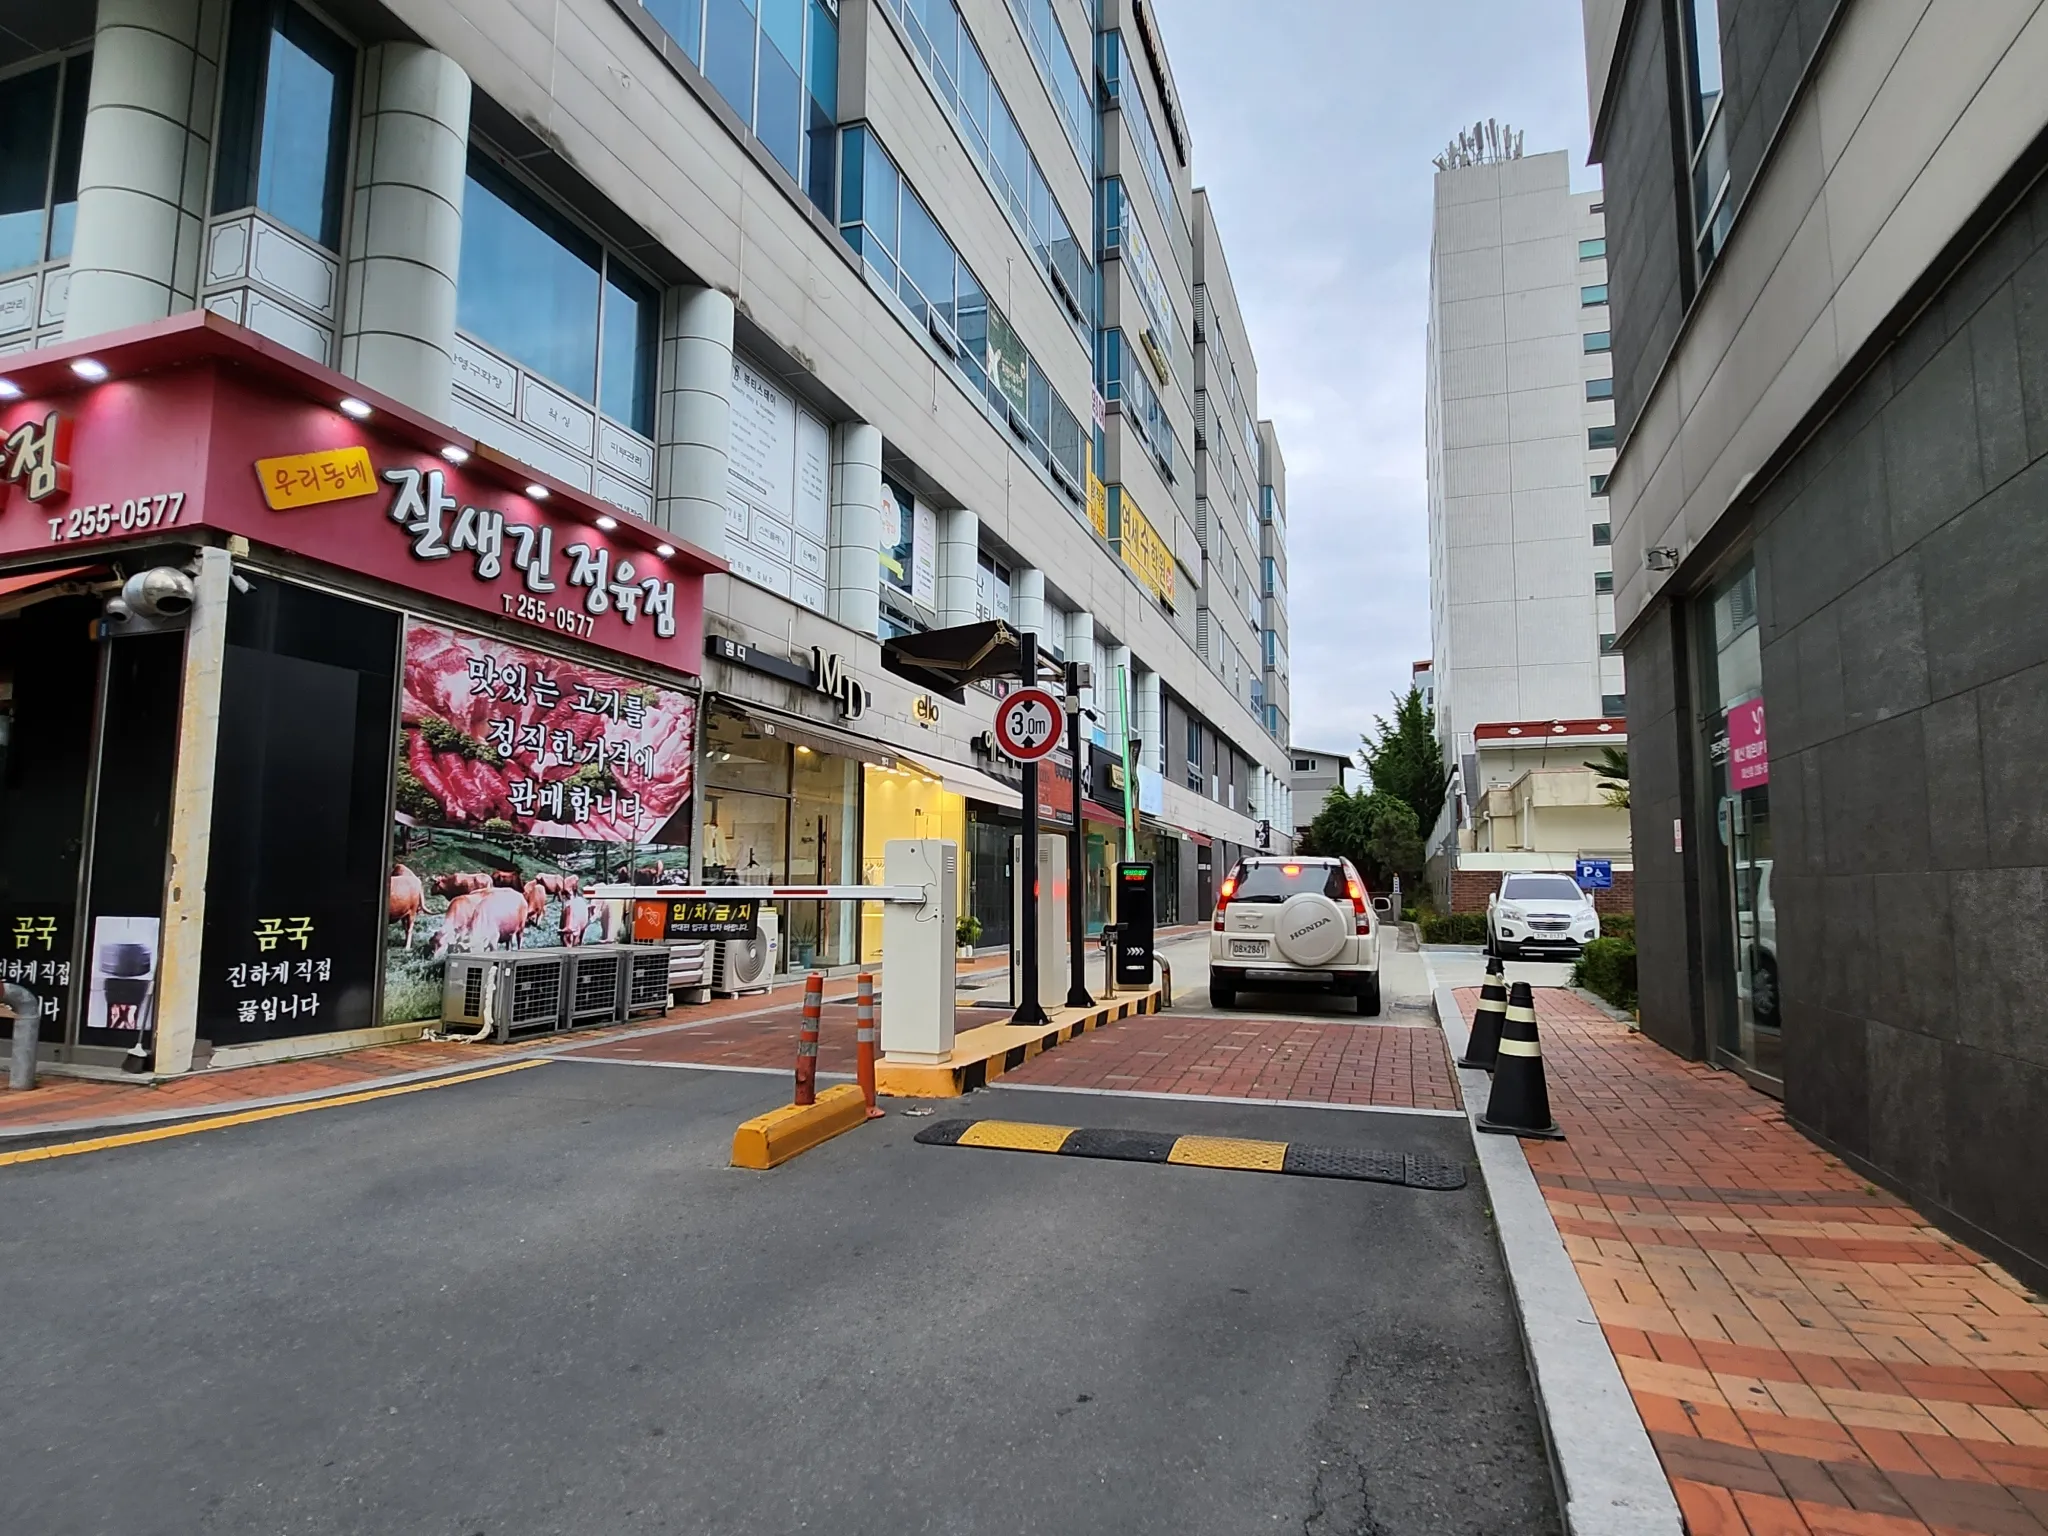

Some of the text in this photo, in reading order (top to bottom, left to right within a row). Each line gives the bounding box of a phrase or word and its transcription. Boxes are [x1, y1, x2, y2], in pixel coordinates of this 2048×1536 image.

[610, 441, 643, 468] 피부관리
[275, 460, 368, 496] 우리동네
[48, 492, 186, 541] T. 255-0577
[381, 467, 677, 638] 잘생긴 정육점
[502, 593, 595, 638] T. 255-0577
[725, 640, 746, 661] 엠디
[467, 656, 646, 729] 맛있는 고기를
[813, 646, 867, 722] MD
[917, 694, 939, 721] ello
[1011, 711, 1046, 736] 3.0m
[487, 717, 654, 780] 정직한 가격에
[508, 778, 645, 827] 판매합니다
[12, 917, 58, 950] 곰국
[253, 917, 314, 952] 곰국
[1289, 917, 1331, 941] HONDA
[40, 960, 70, 986] 직접
[226, 958, 331, 988] 진하게 직접
[237, 992, 320, 1023] 끓입니다
